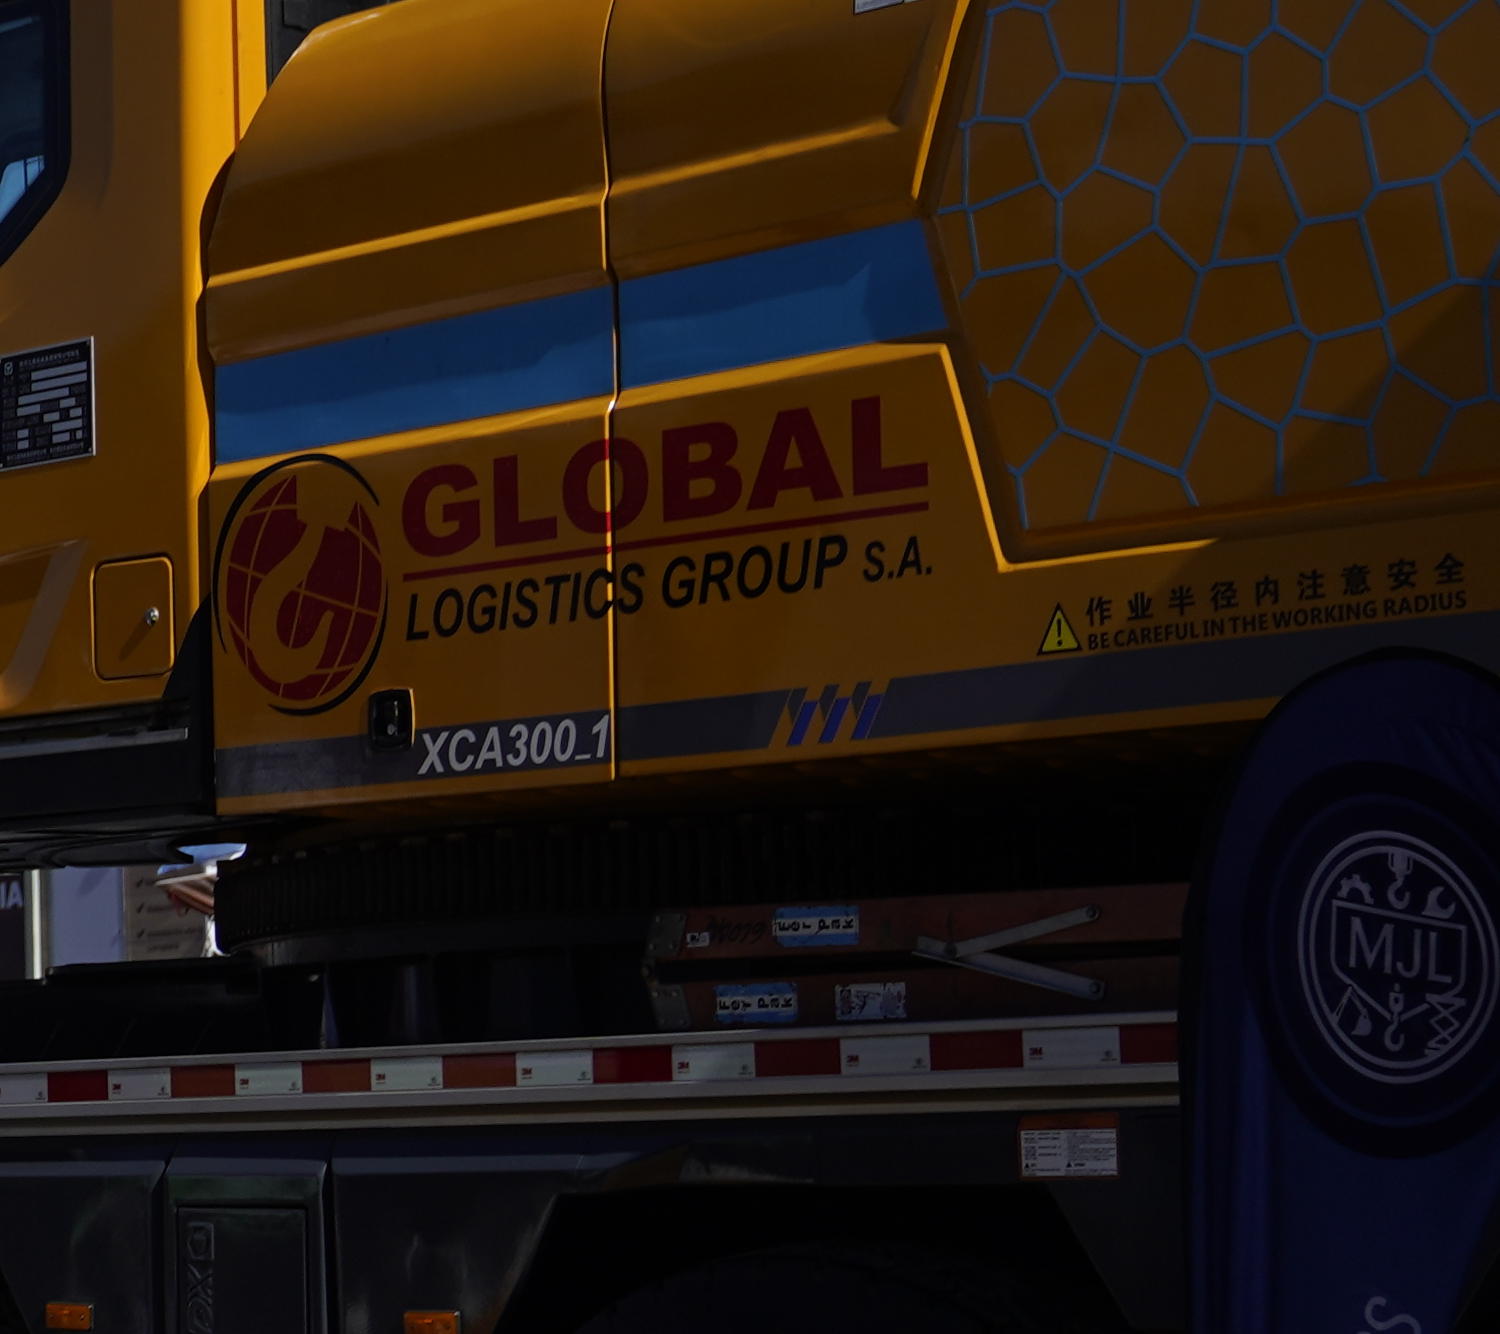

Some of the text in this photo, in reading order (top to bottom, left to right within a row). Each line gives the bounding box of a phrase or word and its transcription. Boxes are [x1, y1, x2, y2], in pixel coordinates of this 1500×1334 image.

[402, 396, 929, 559] GLOBAL
[404, 534, 933, 642] LOGISTICS GROUP S.A.
[1086, 553, 1465, 626] 作业半径内注意安全
[1088, 590, 1467, 650] BE CAREFUL IN THE WORKING RADIUS
[1348, 917, 1452, 984] MJL
